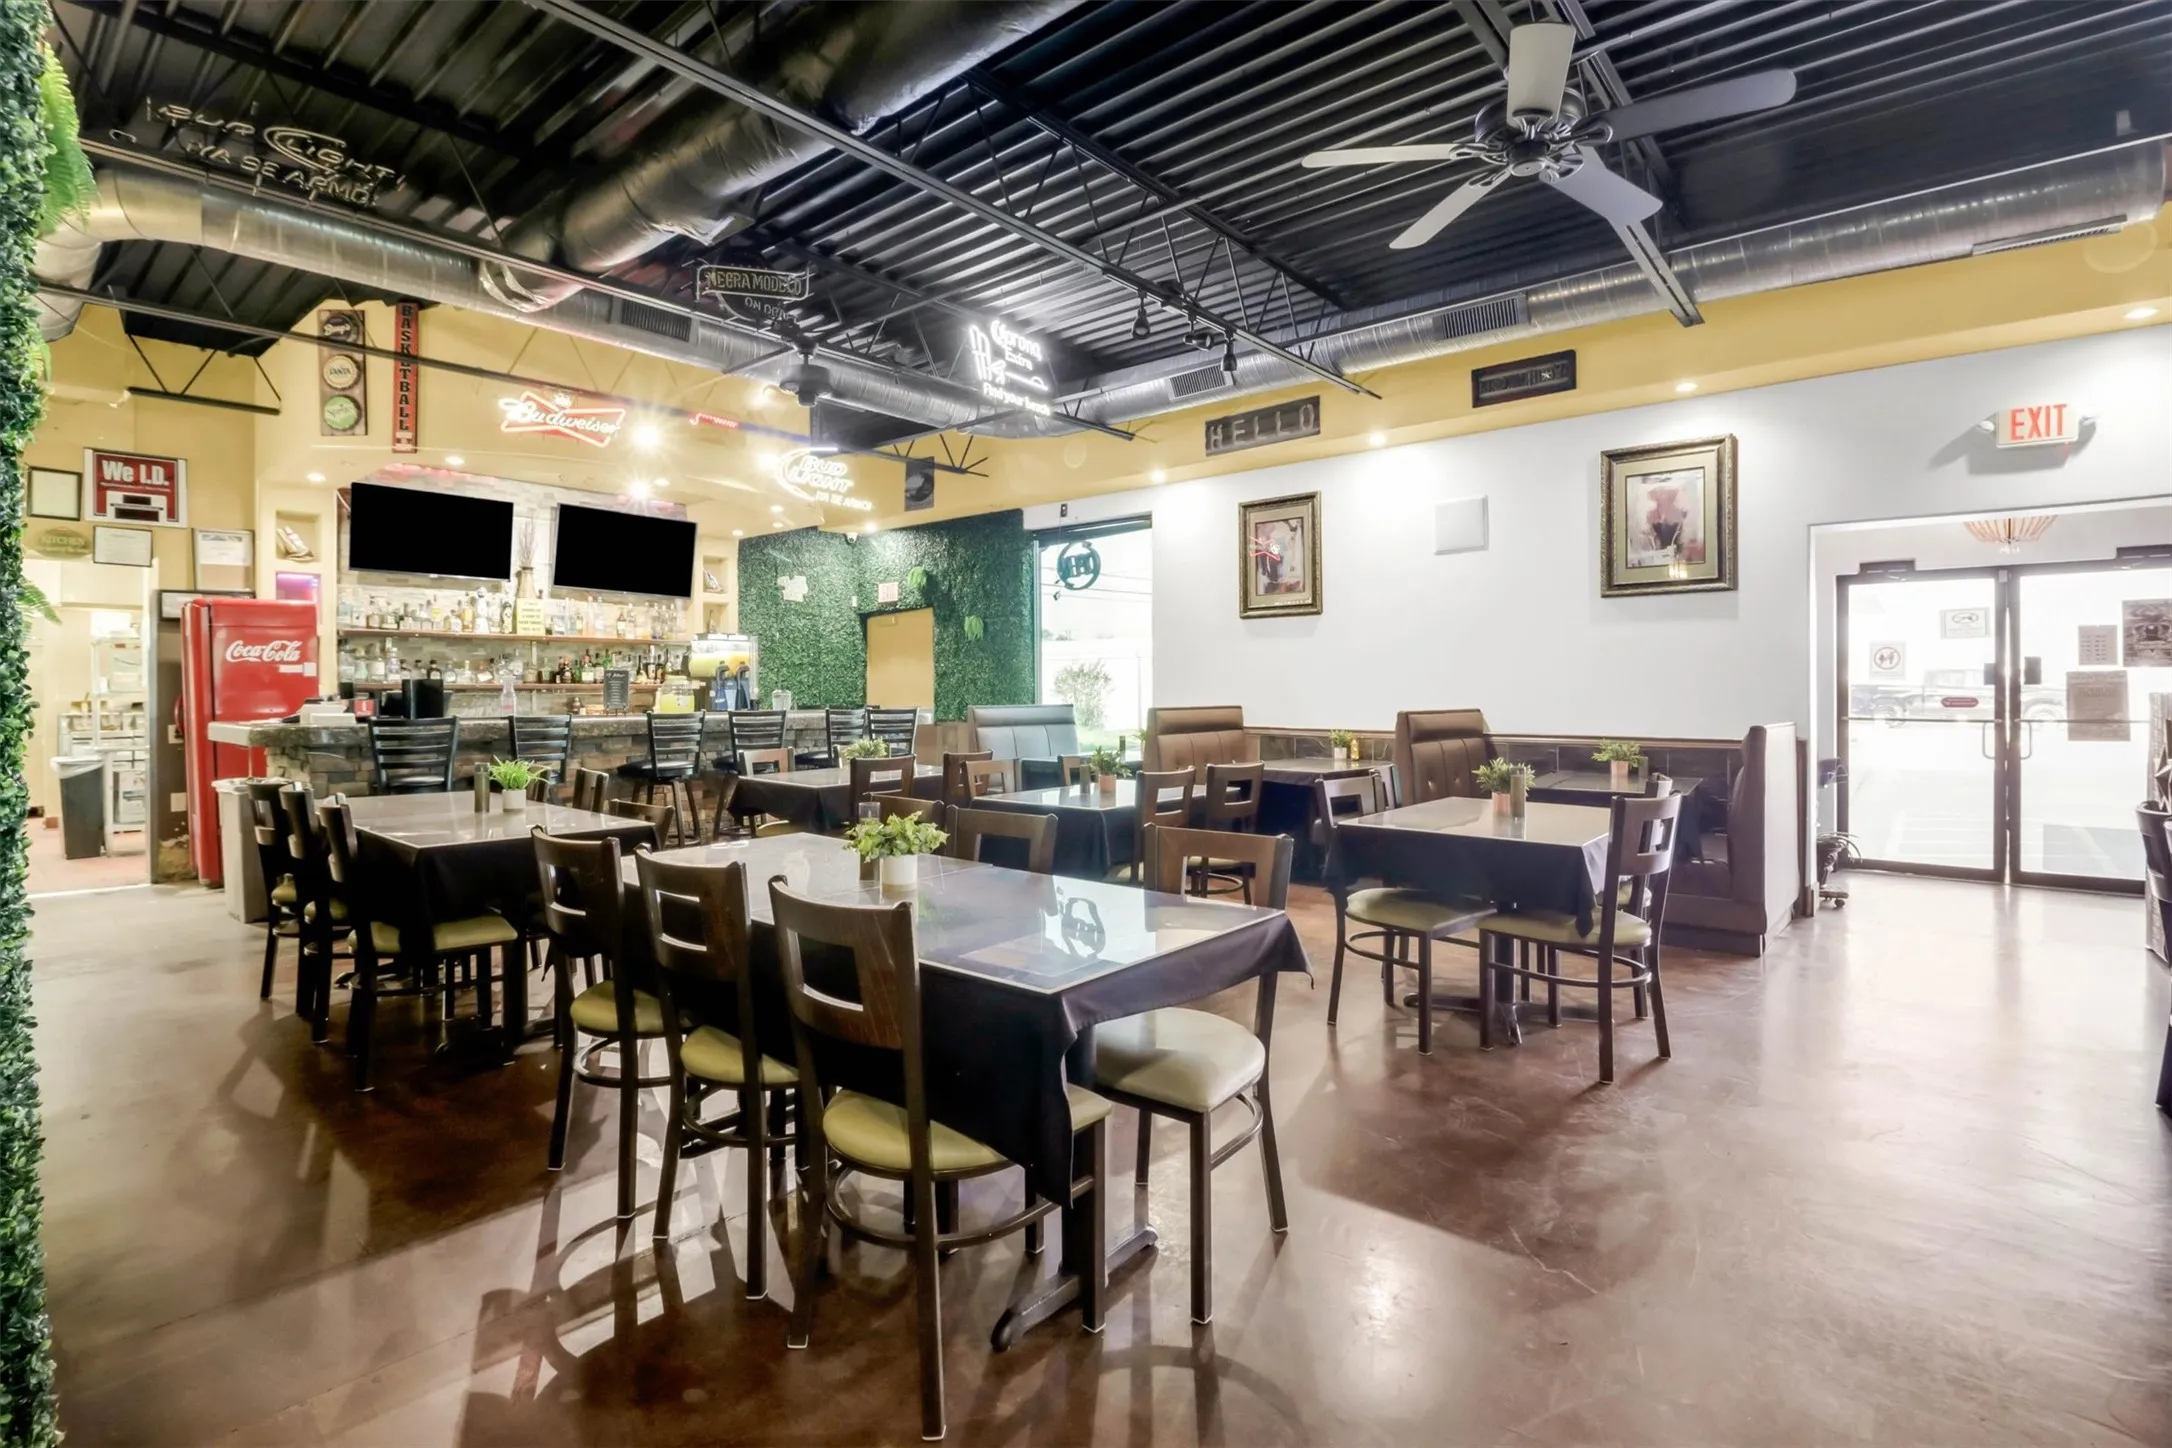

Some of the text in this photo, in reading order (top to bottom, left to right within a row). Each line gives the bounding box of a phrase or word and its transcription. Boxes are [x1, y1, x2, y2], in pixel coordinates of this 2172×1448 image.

[706, 271, 751, 289] NEGRA
[744, 296, 761, 311] ON
[499, 397, 619, 438] Budweiser
[1209, 403, 1315, 451] HELLO
[2009, 403, 2068, 441] EXIT
[101, 460, 170, 486] We I.D.
[225, 639, 303, 663] Coca-Cola
